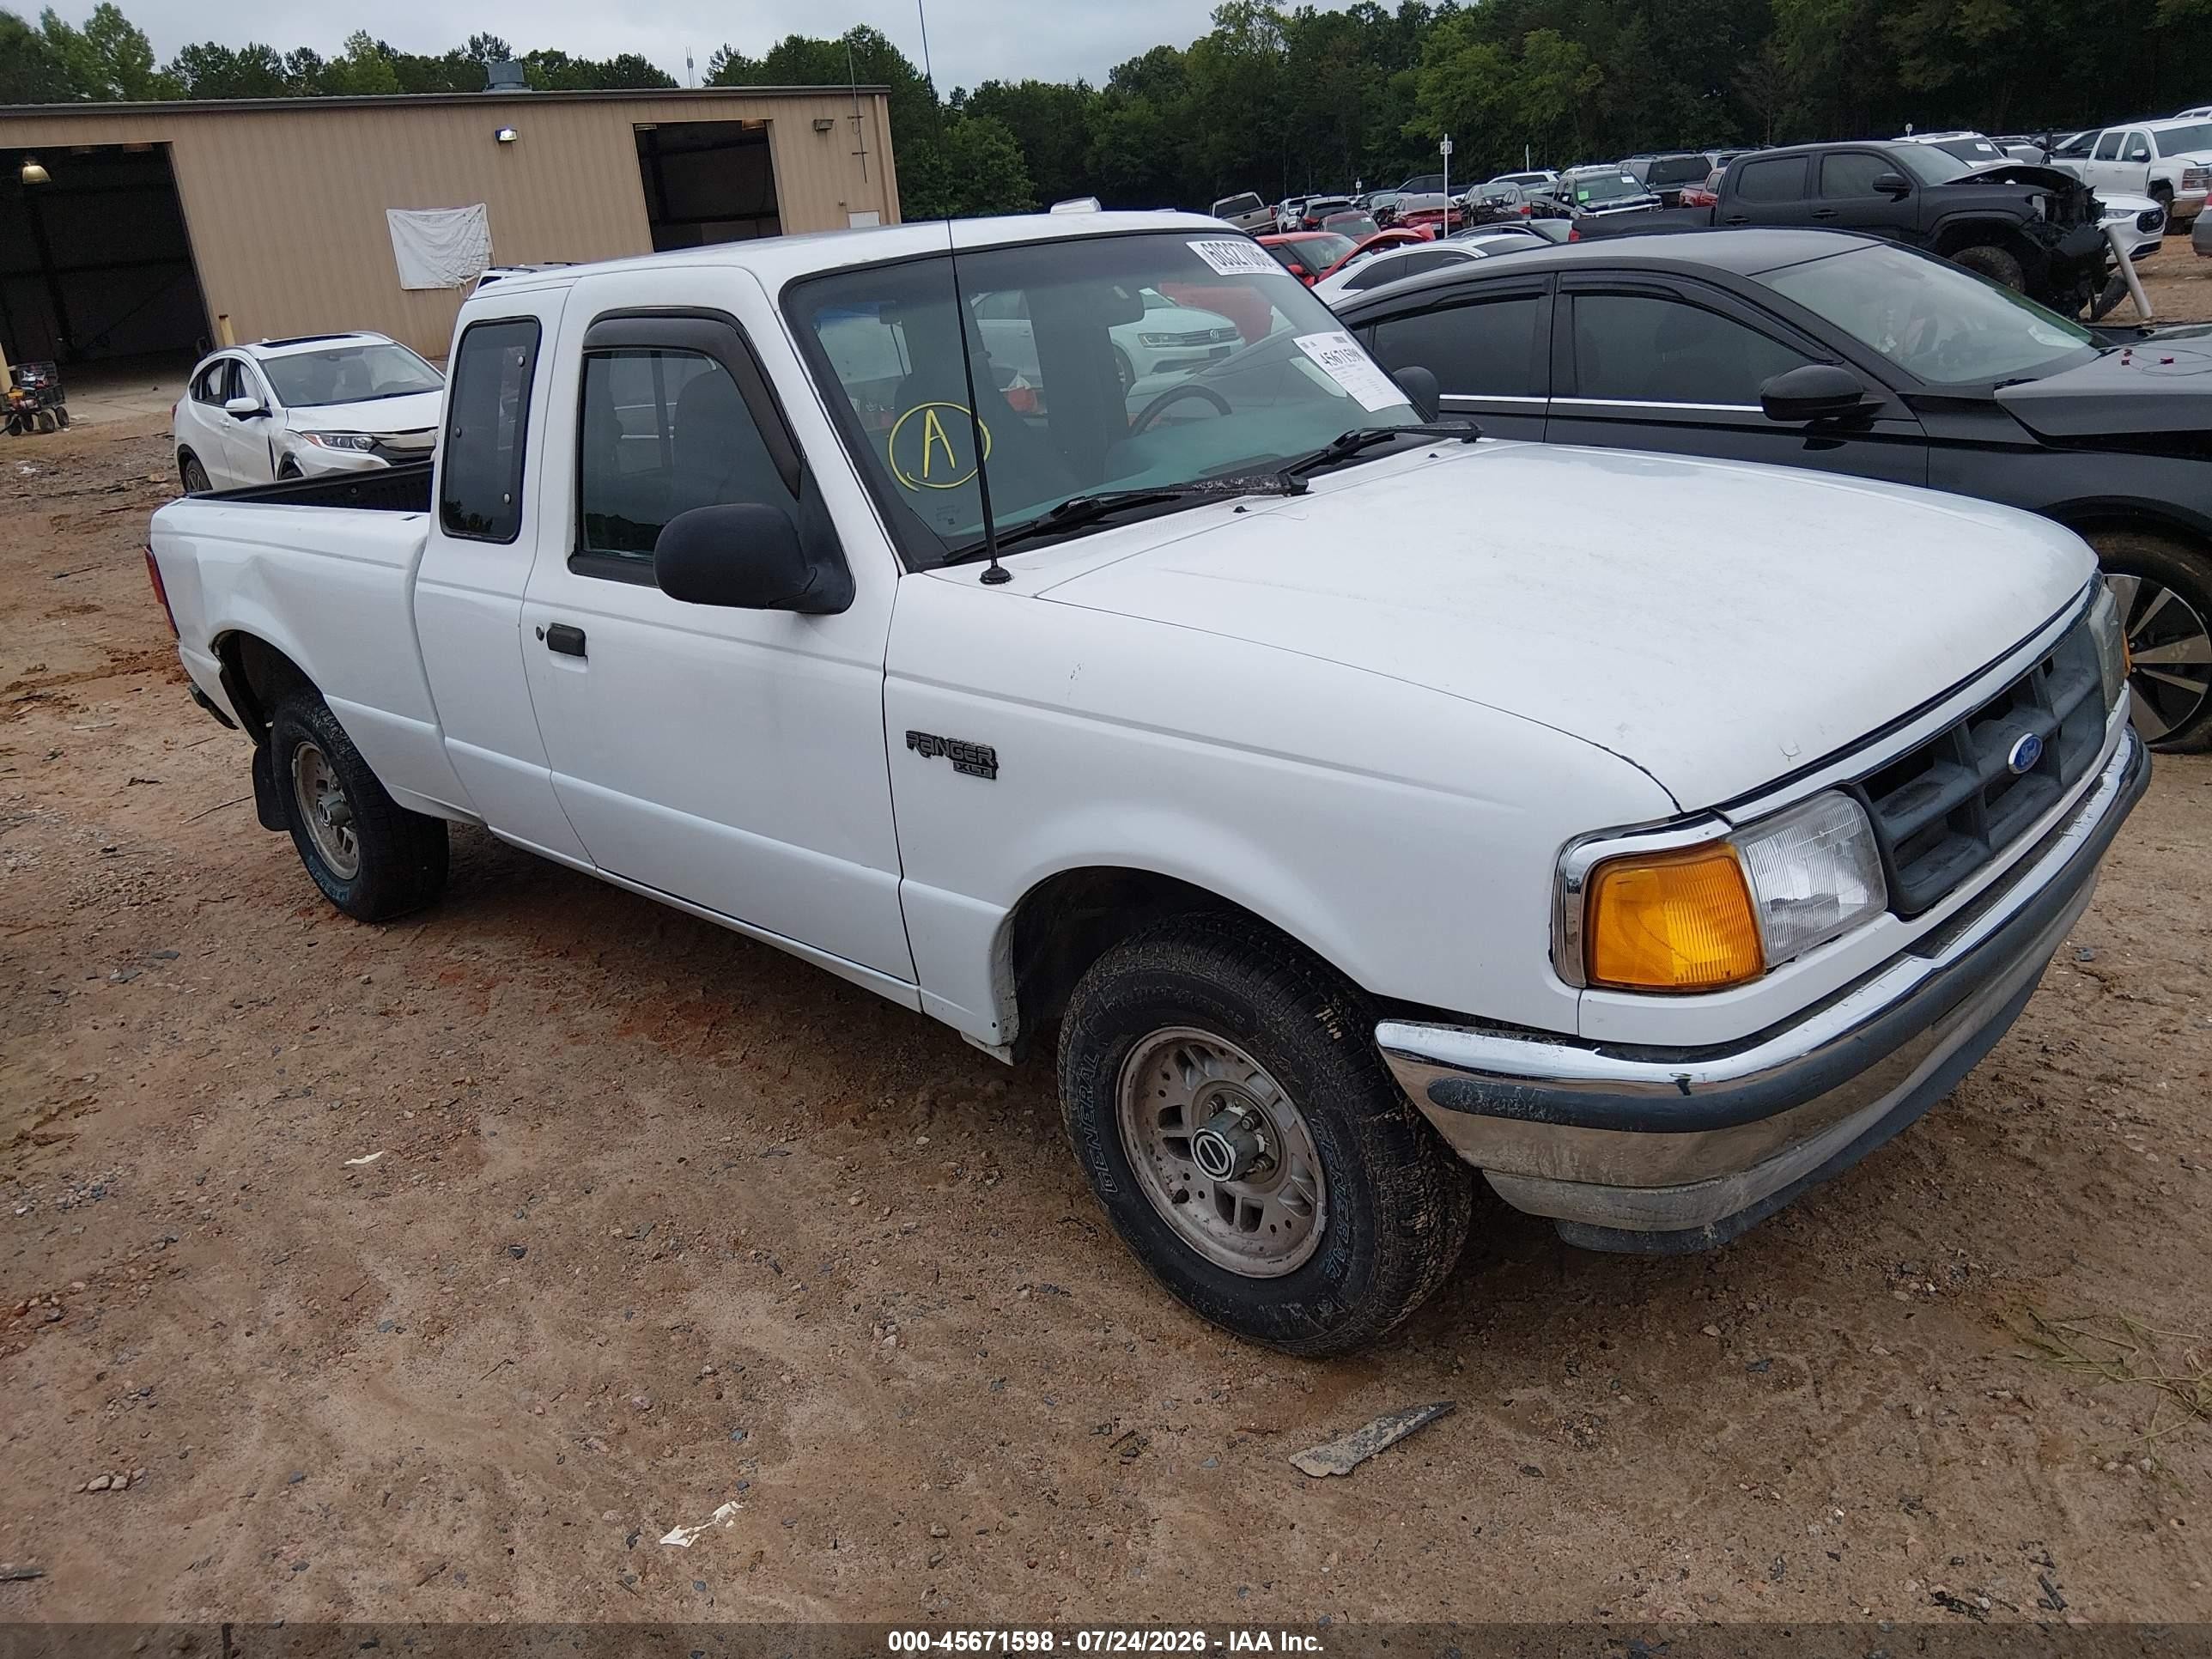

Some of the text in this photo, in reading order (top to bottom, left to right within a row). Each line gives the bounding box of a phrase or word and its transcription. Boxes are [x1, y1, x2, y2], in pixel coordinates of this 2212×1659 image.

[923, 409, 956, 478] A
[906, 731, 996, 767] RANGER
[955, 762, 991, 776] XLT
[1078, 1053, 1118, 1193] GENERAL
